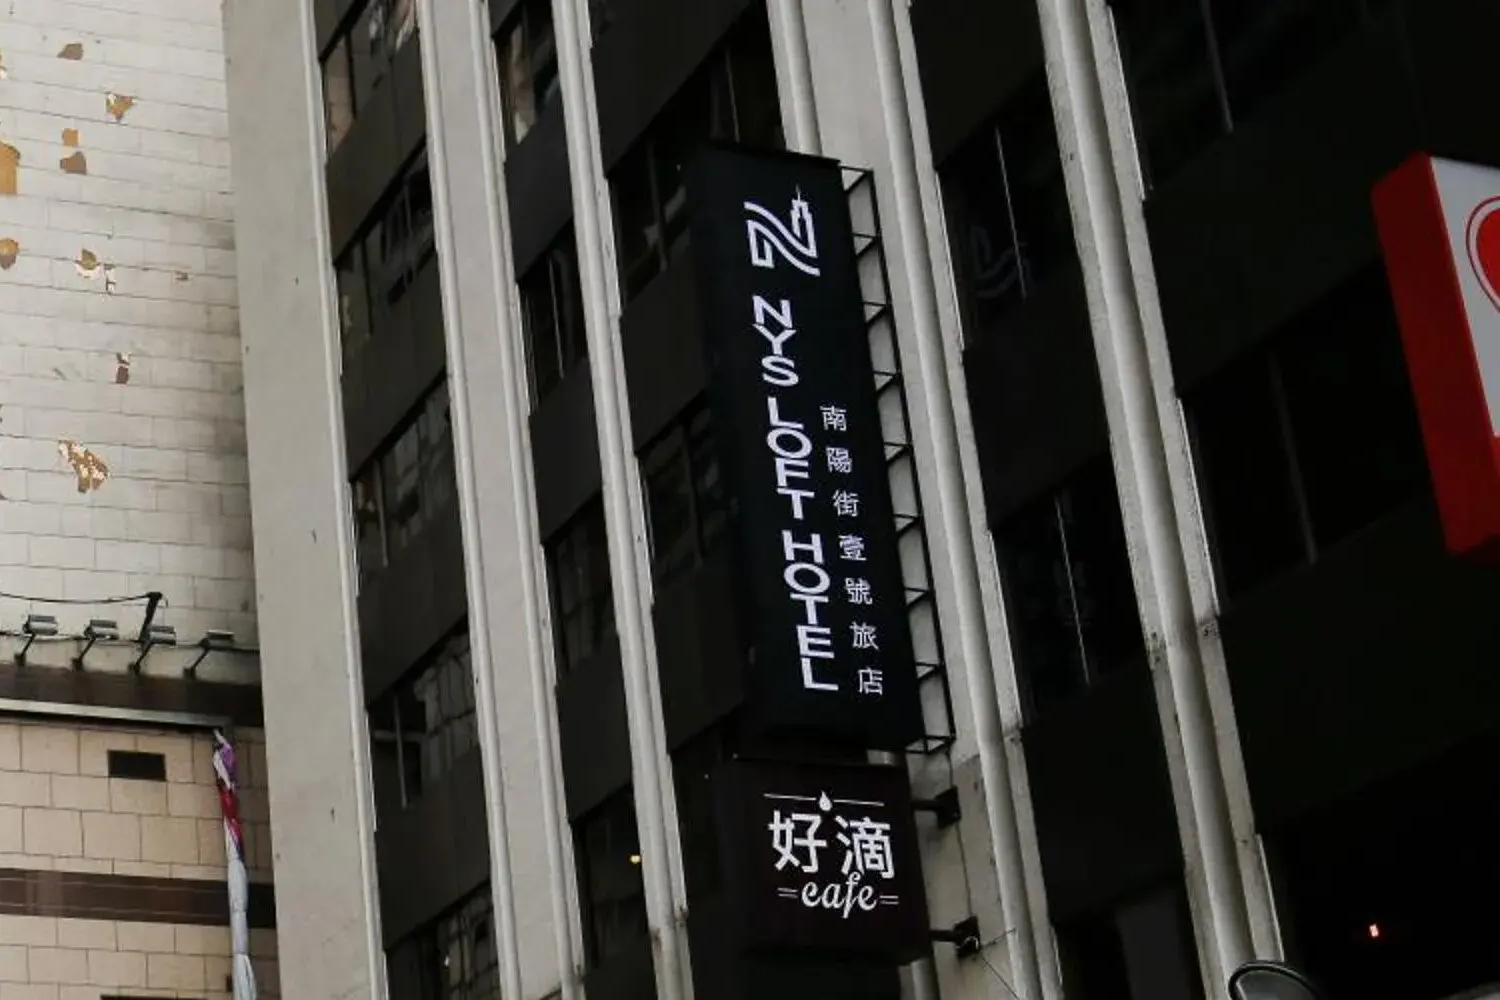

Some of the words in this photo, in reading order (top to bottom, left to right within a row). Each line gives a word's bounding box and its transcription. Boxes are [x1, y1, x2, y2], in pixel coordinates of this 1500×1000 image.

[752, 295, 799, 388] NYS
[766, 396, 815, 521] LOFT
[819, 405, 884, 695] 南陽街壹號旅店
[782, 529, 840, 692] HOTEL
[767, 810, 896, 879] 好滴
[801, 871, 877, 919] cafe
